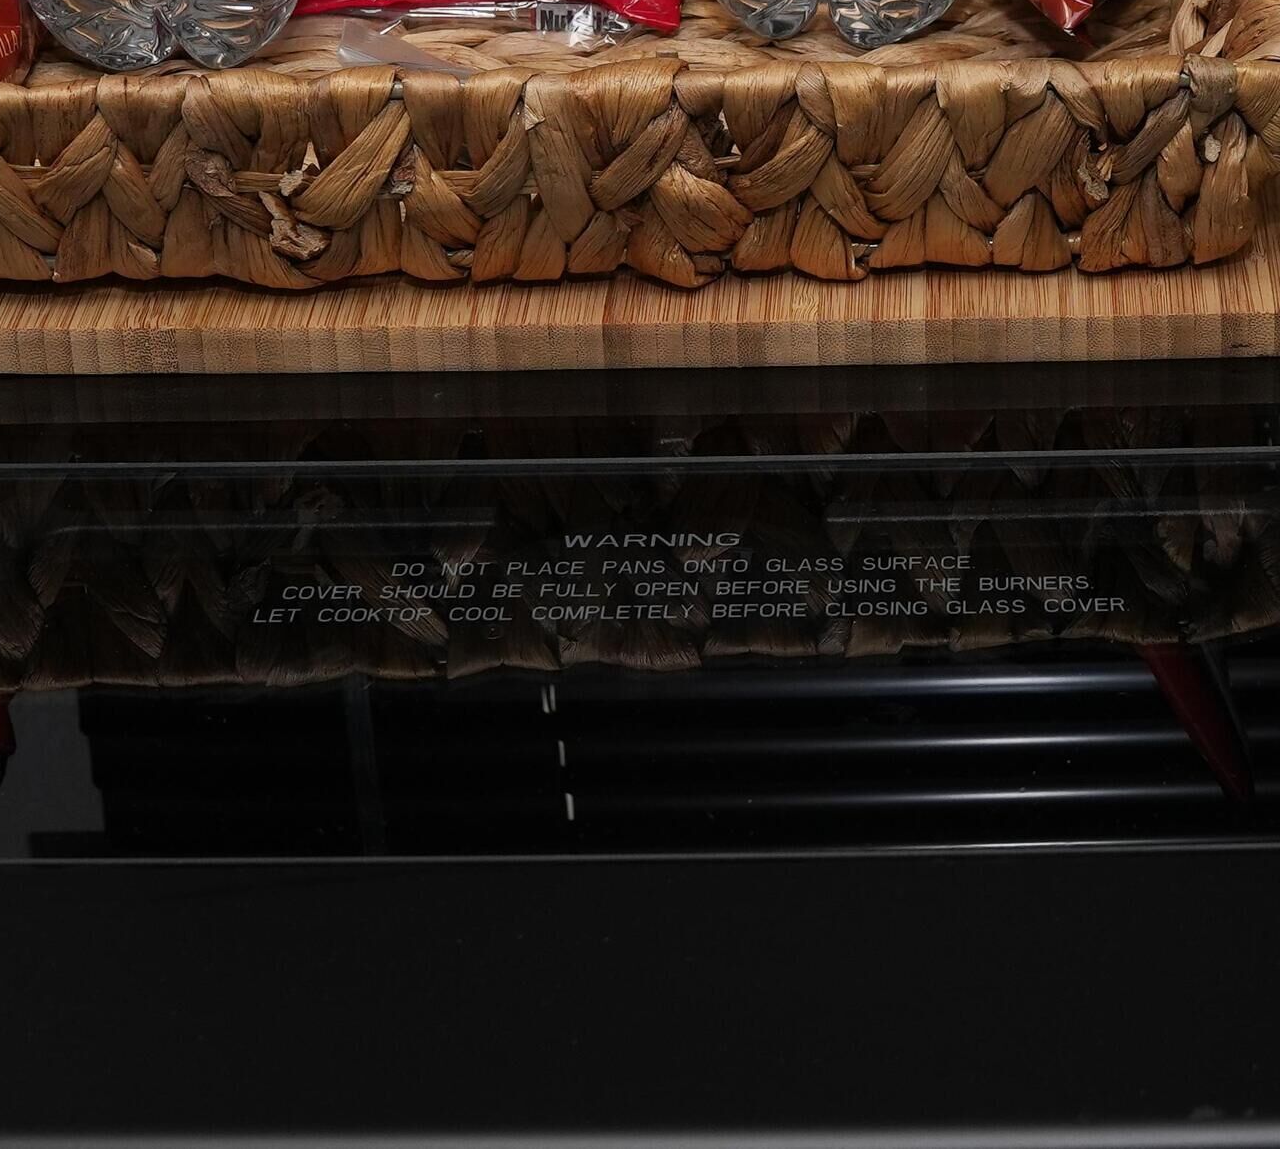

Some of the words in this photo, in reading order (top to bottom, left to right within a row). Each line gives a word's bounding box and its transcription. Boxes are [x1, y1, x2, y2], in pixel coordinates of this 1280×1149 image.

[564, 533, 741, 549] WARNING
[391, 562, 425, 577] DO
[442, 561, 491, 577] NOT
[507, 560, 585, 576] PLACE
[601, 559, 666, 575] PANS
[683, 558, 749, 574] ONTO
[765, 557, 844, 572] GLASS
[862, 556, 976, 571] SURFACE.
[282, 585, 362, 601] COVER
[380, 584, 475, 600] SHOULD
[492, 584, 523, 598] BE
[540, 583, 617, 598] FULLY
[634, 581, 699, 597] OPEN
[716, 580, 810, 595] BEFORE
[827, 579, 897, 594] USING
[915, 578, 961, 593] THE
[978, 576, 1096, 592] BURNERS.
[253, 609, 301, 624] LET
[317, 607, 433, 623] COOKTOP
[448, 606, 513, 622] COOL
[532, 604, 694, 621] COMPLETELY
[712, 603, 808, 619] BEFORE
[825, 601, 928, 617] CLOSING
[946, 599, 1026, 615] GLASS
[1043, 598, 1131, 614] COVER.
